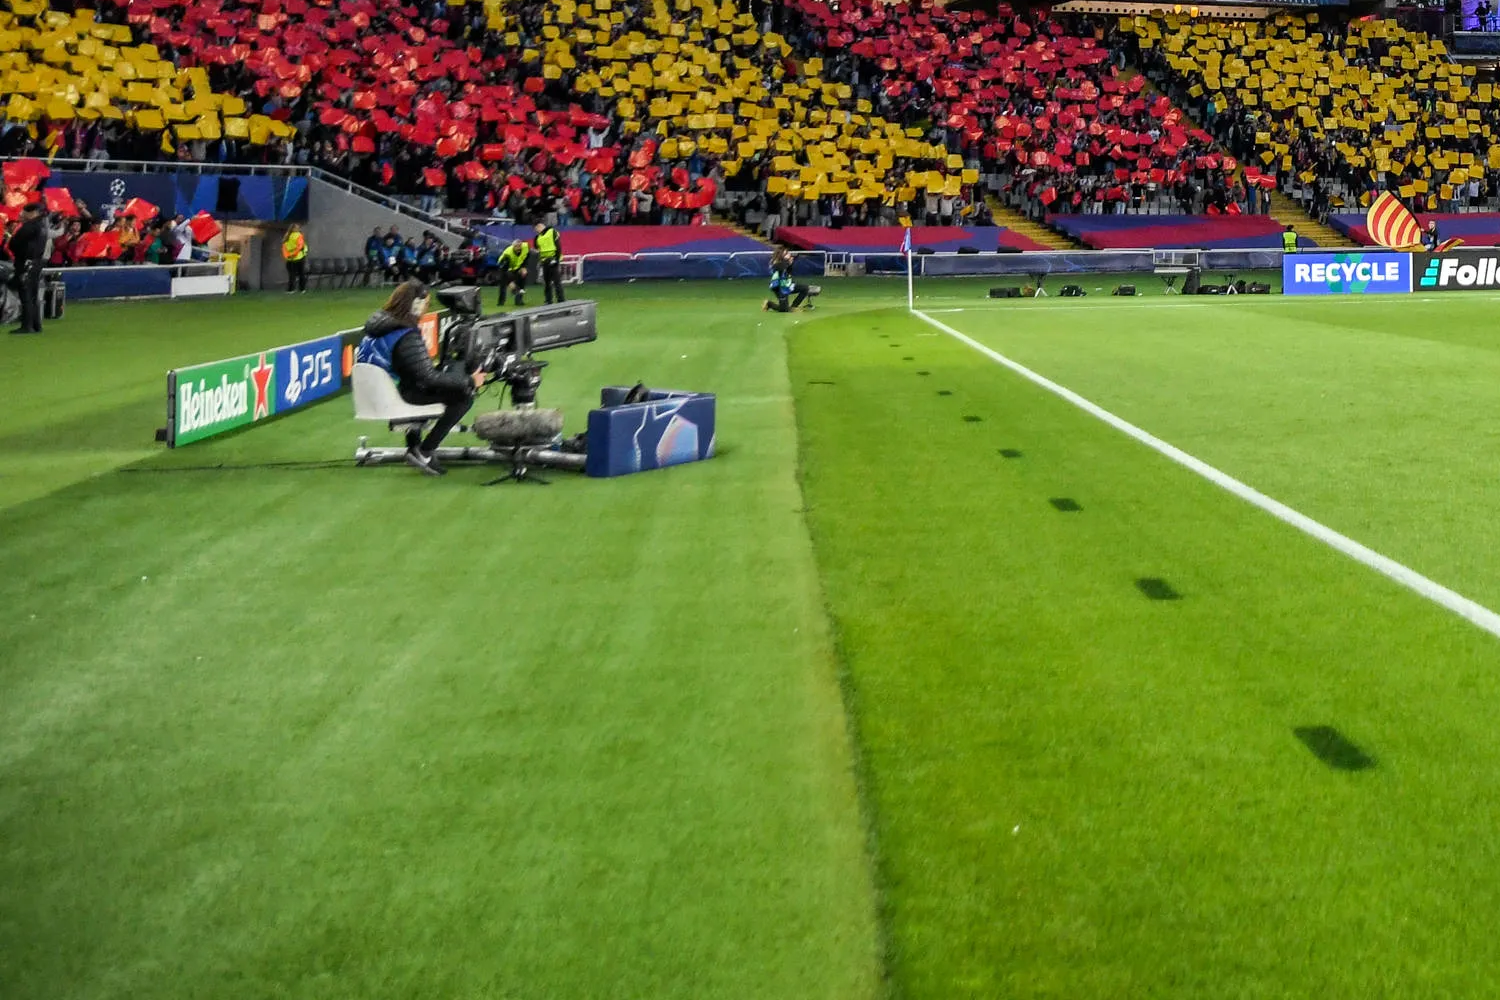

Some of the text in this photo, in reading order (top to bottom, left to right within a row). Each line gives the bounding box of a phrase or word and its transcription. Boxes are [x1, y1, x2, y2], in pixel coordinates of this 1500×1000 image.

[1294, 261, 1400, 283] RECYCLE
[302, 349, 333, 393] PS5
[179, 374, 249, 435] Heineken
